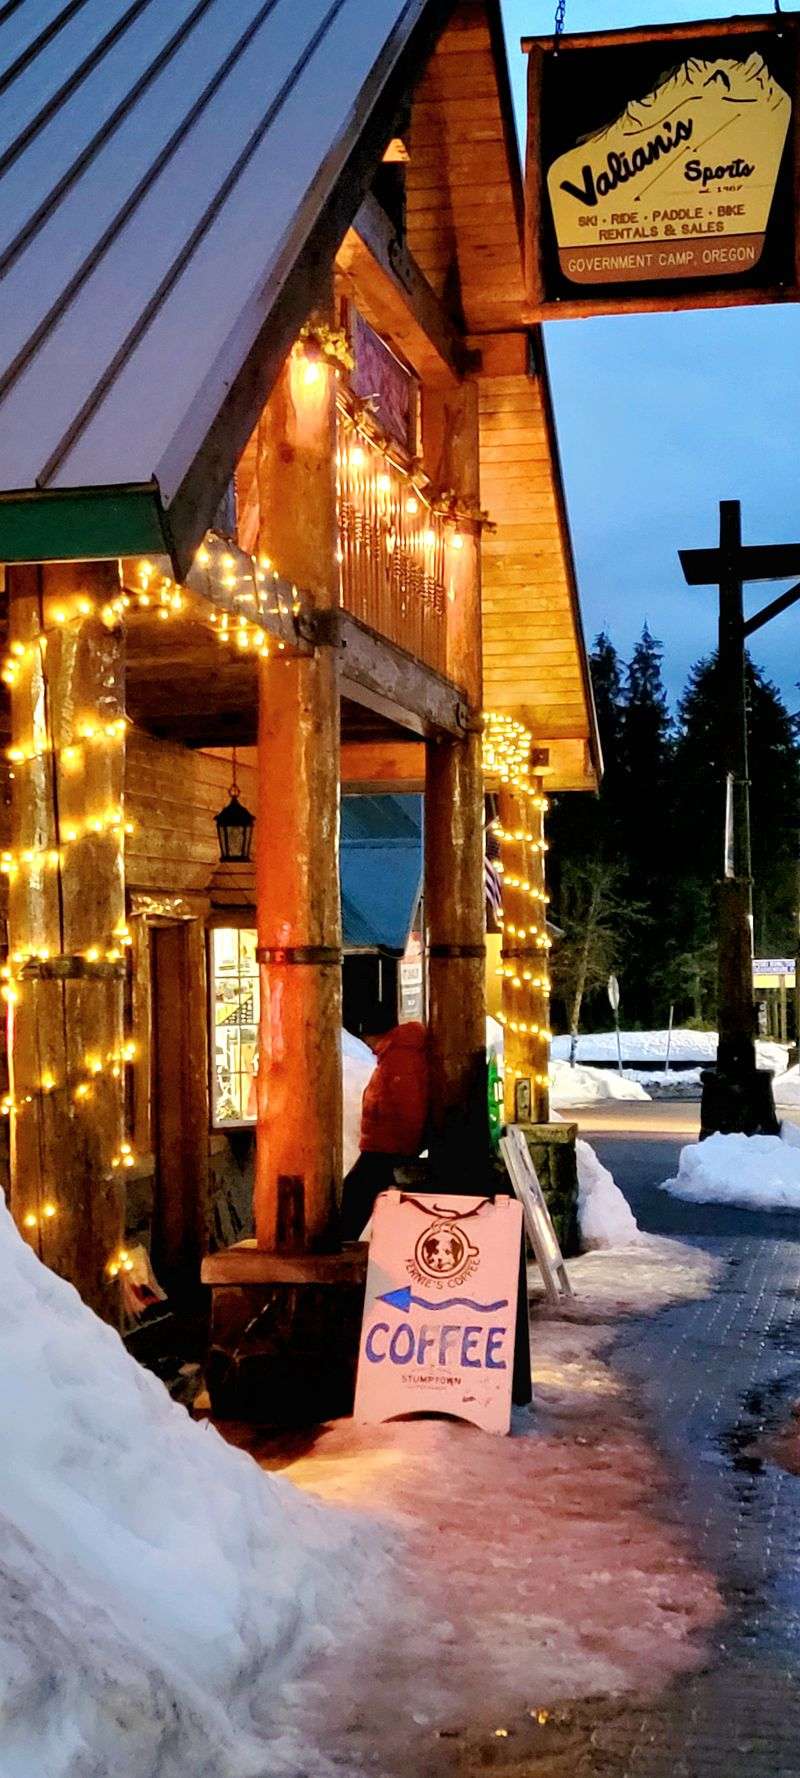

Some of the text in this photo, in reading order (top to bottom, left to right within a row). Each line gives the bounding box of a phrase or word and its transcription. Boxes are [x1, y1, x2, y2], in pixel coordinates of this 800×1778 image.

[560, 117, 693, 207] Valian's
[684, 158, 755, 187] Sports
[578, 204, 746, 227] SKI RIDE PADDLE BIKE
[599, 221, 724, 241] RENTALS & SALES
[568, 253, 652, 273] GOVERNMENT
[702, 247, 755, 264] OREGON
[447, 1259, 481, 1289] COFFEE
[365, 1322, 507, 1370] COFFEE
[401, 1375, 462, 1386] STUMPTOWN
